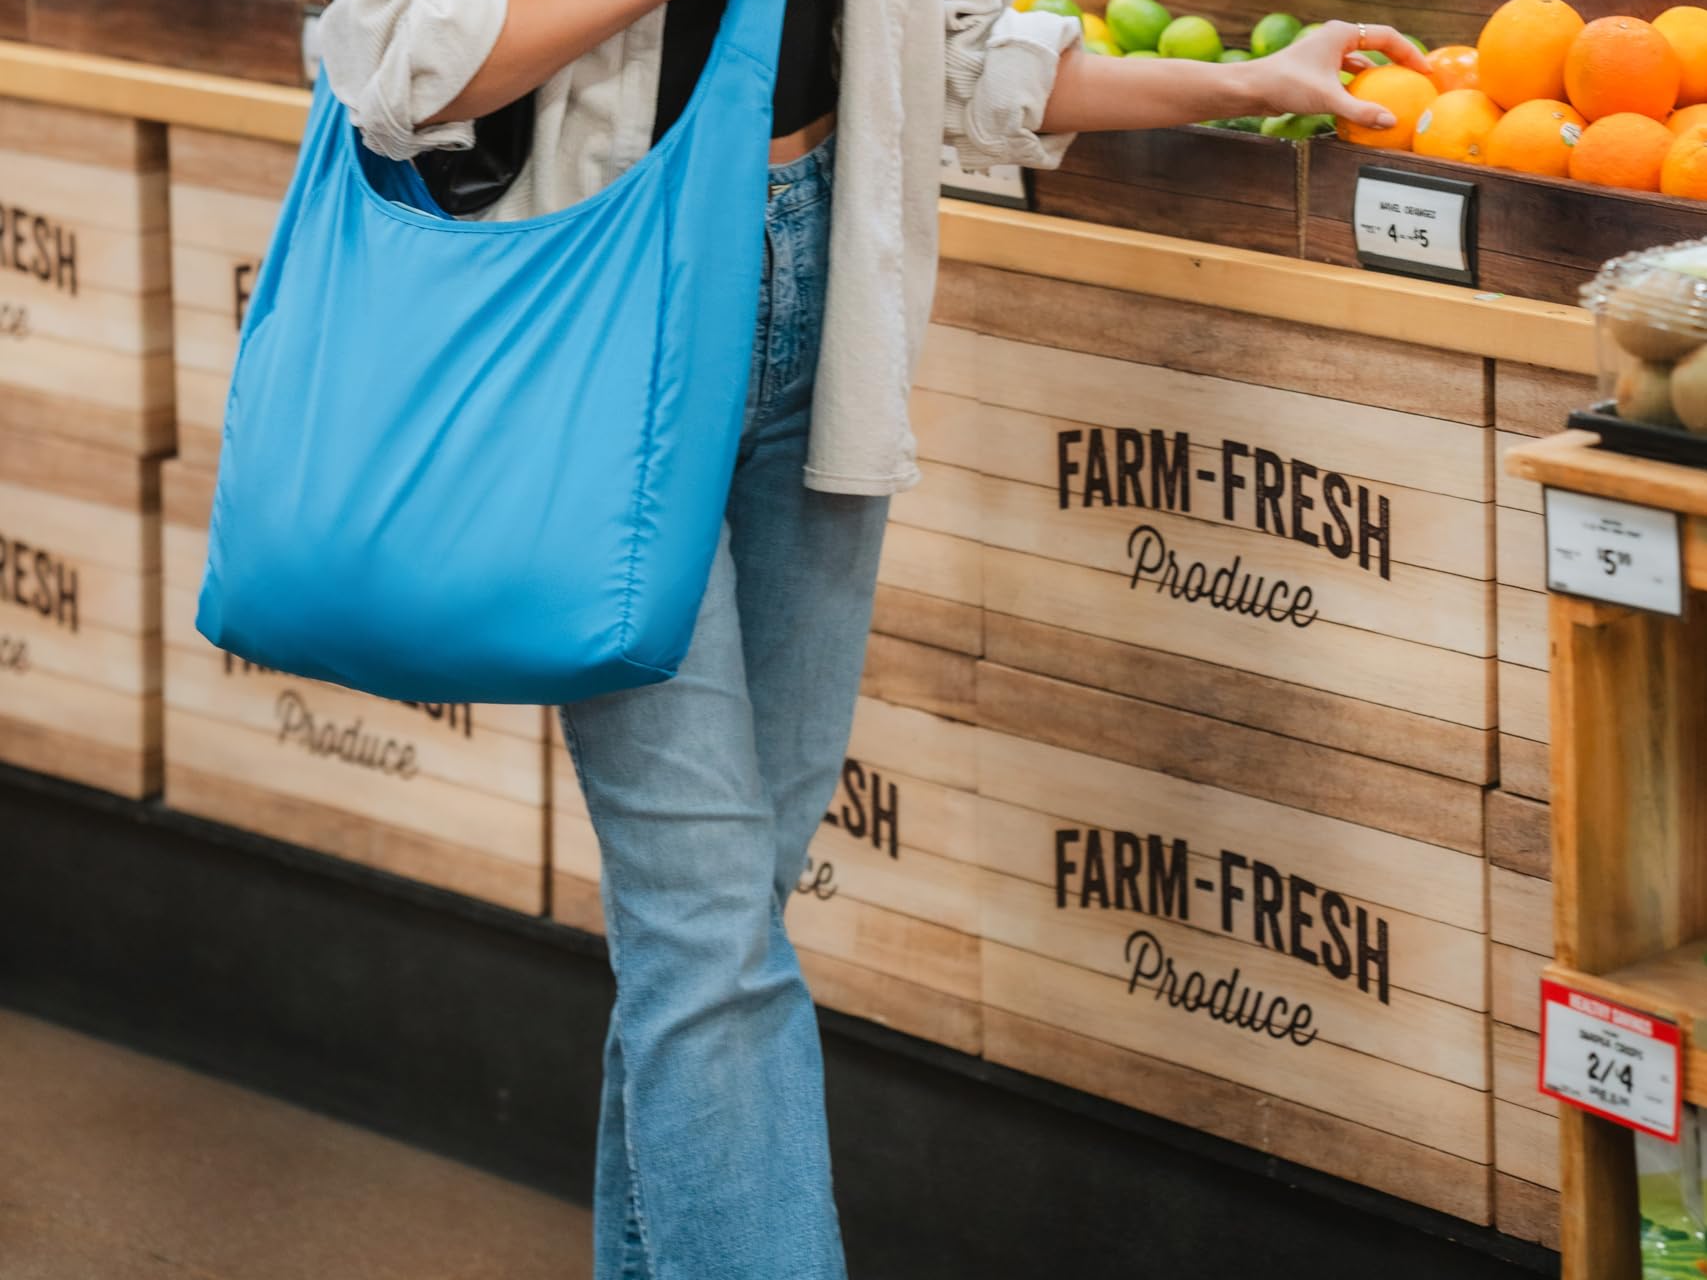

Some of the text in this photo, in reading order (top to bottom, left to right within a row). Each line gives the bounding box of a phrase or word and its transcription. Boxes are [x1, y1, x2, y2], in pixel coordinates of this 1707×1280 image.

[1057, 427, 1392, 581] FARM-FRESH
[1127, 524, 1319, 628] Produce
[275, 689, 420, 780] Produce
[822, 756, 899, 861] SH
[1055, 829, 1391, 1006] FARM-FRESH
[1124, 930, 1318, 1046] Produce
